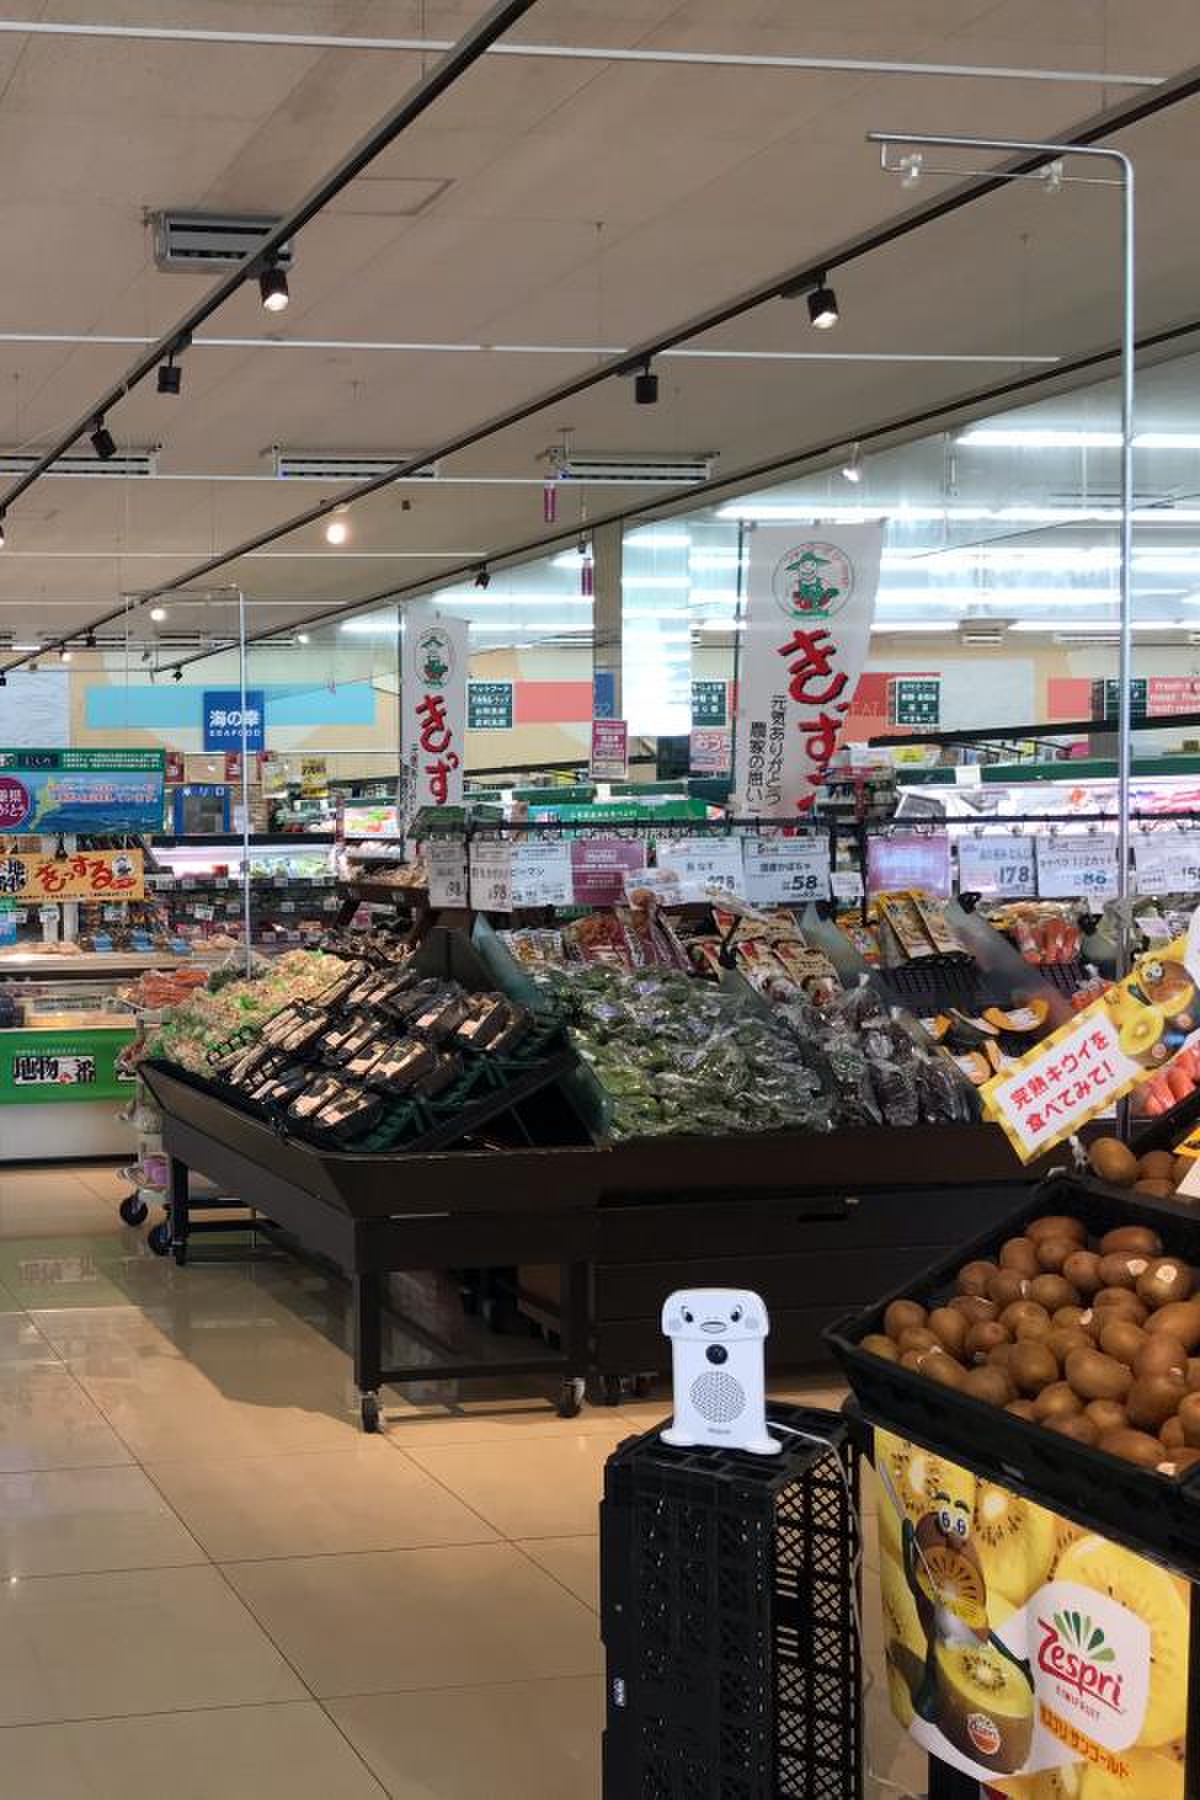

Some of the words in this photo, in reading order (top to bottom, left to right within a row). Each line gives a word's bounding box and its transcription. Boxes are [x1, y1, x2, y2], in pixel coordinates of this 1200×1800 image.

[209, 710, 261, 728] 海の幸
[209, 729, 261, 737] SEAFOOD
[791, 874, 819, 890] 58
[1000, 866, 1030, 883] 178
[1010, 1030, 1110, 1110] 完熟キウイを
[1025, 1061, 1116, 1134] 食べてみて!
[1038, 1616, 1123, 1712] Zespri
